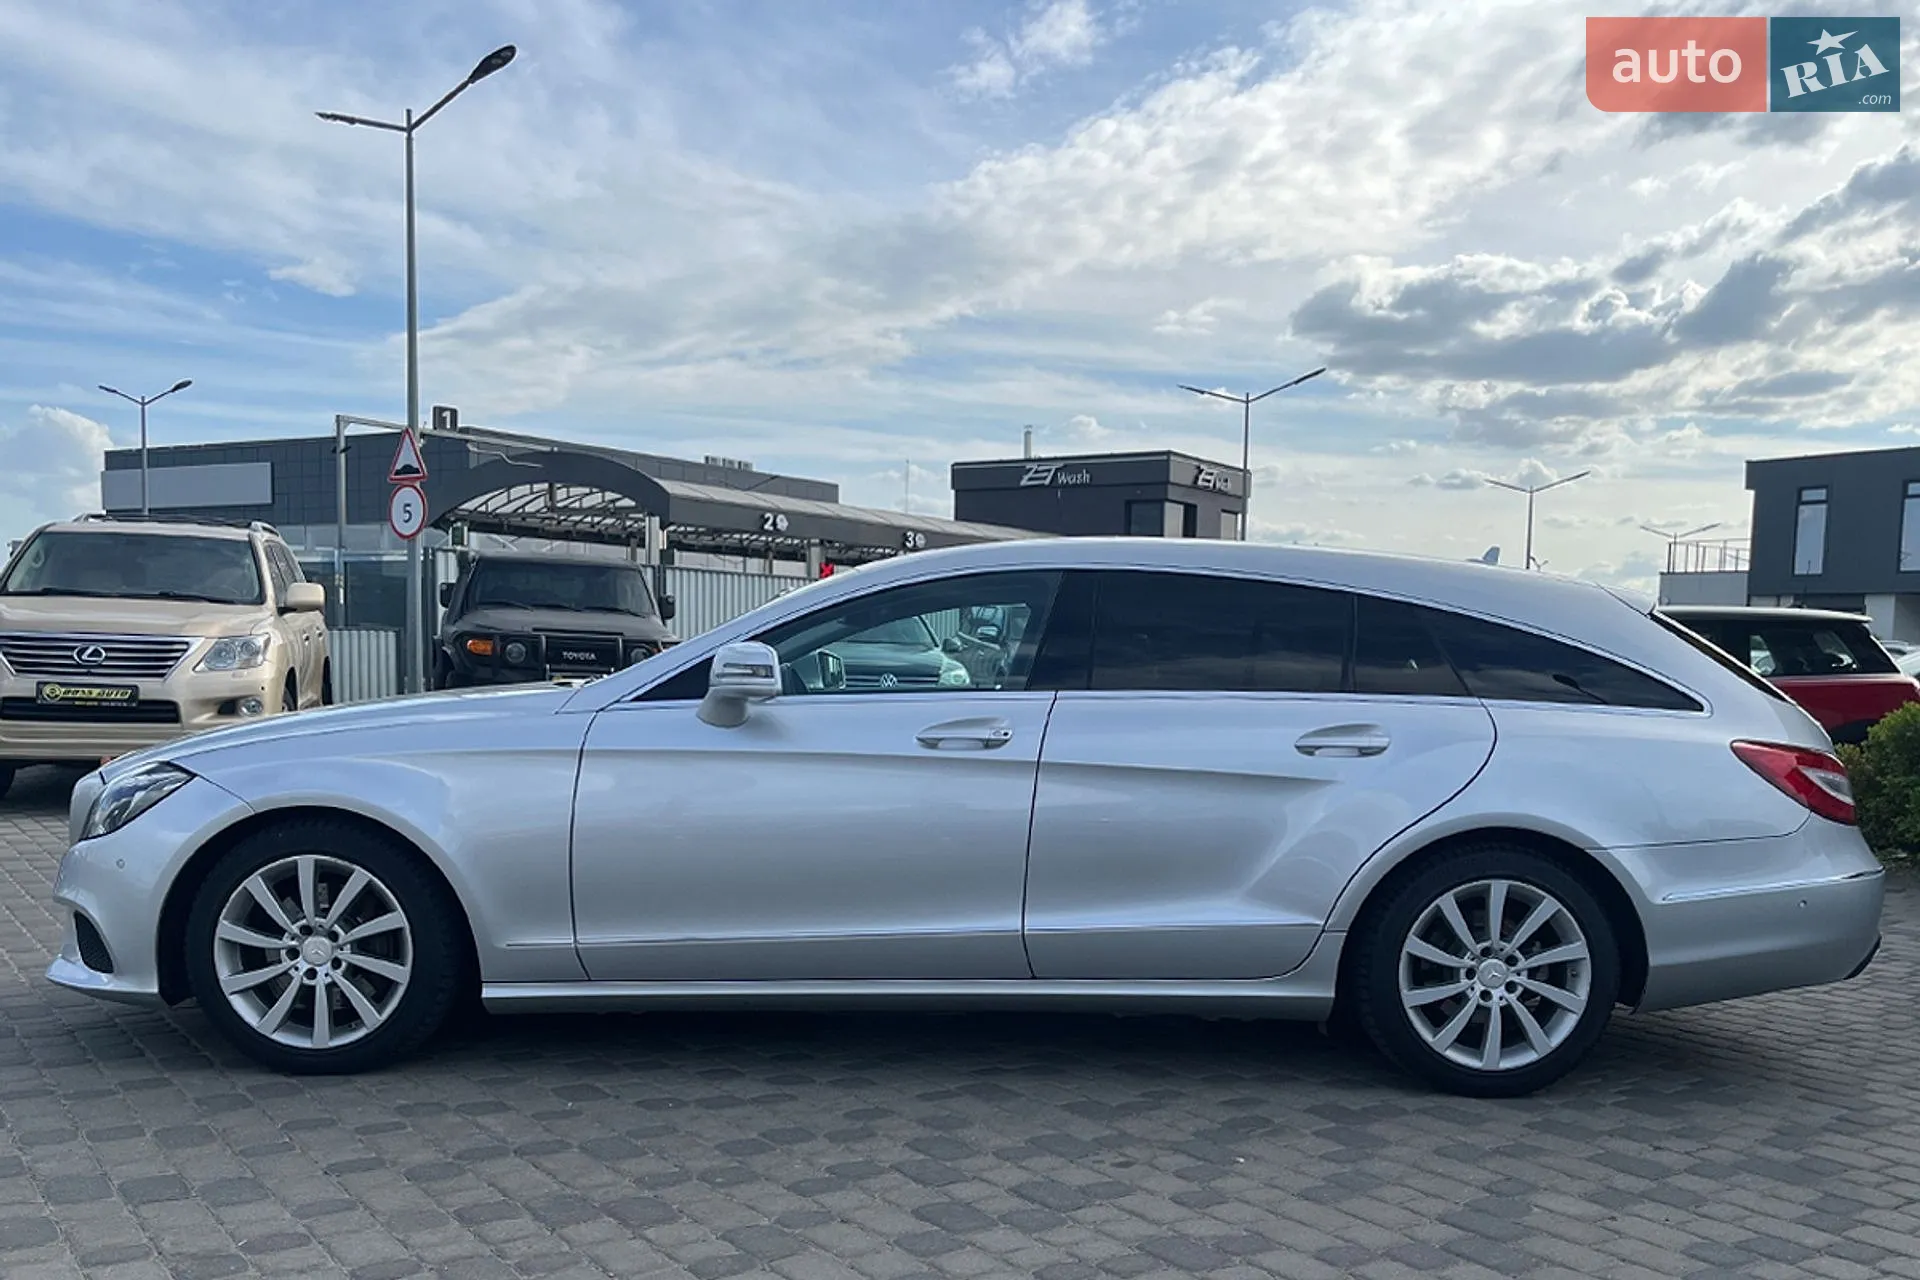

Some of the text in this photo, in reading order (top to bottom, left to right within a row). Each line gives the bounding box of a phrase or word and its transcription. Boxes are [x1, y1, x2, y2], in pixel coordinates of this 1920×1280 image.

[442, 410, 452, 429] 1
[402, 503, 413, 523] 5
[763, 512, 775, 531] 2
[905, 531, 915, 548] 3
[562, 651, 597, 660] TOYOTA
